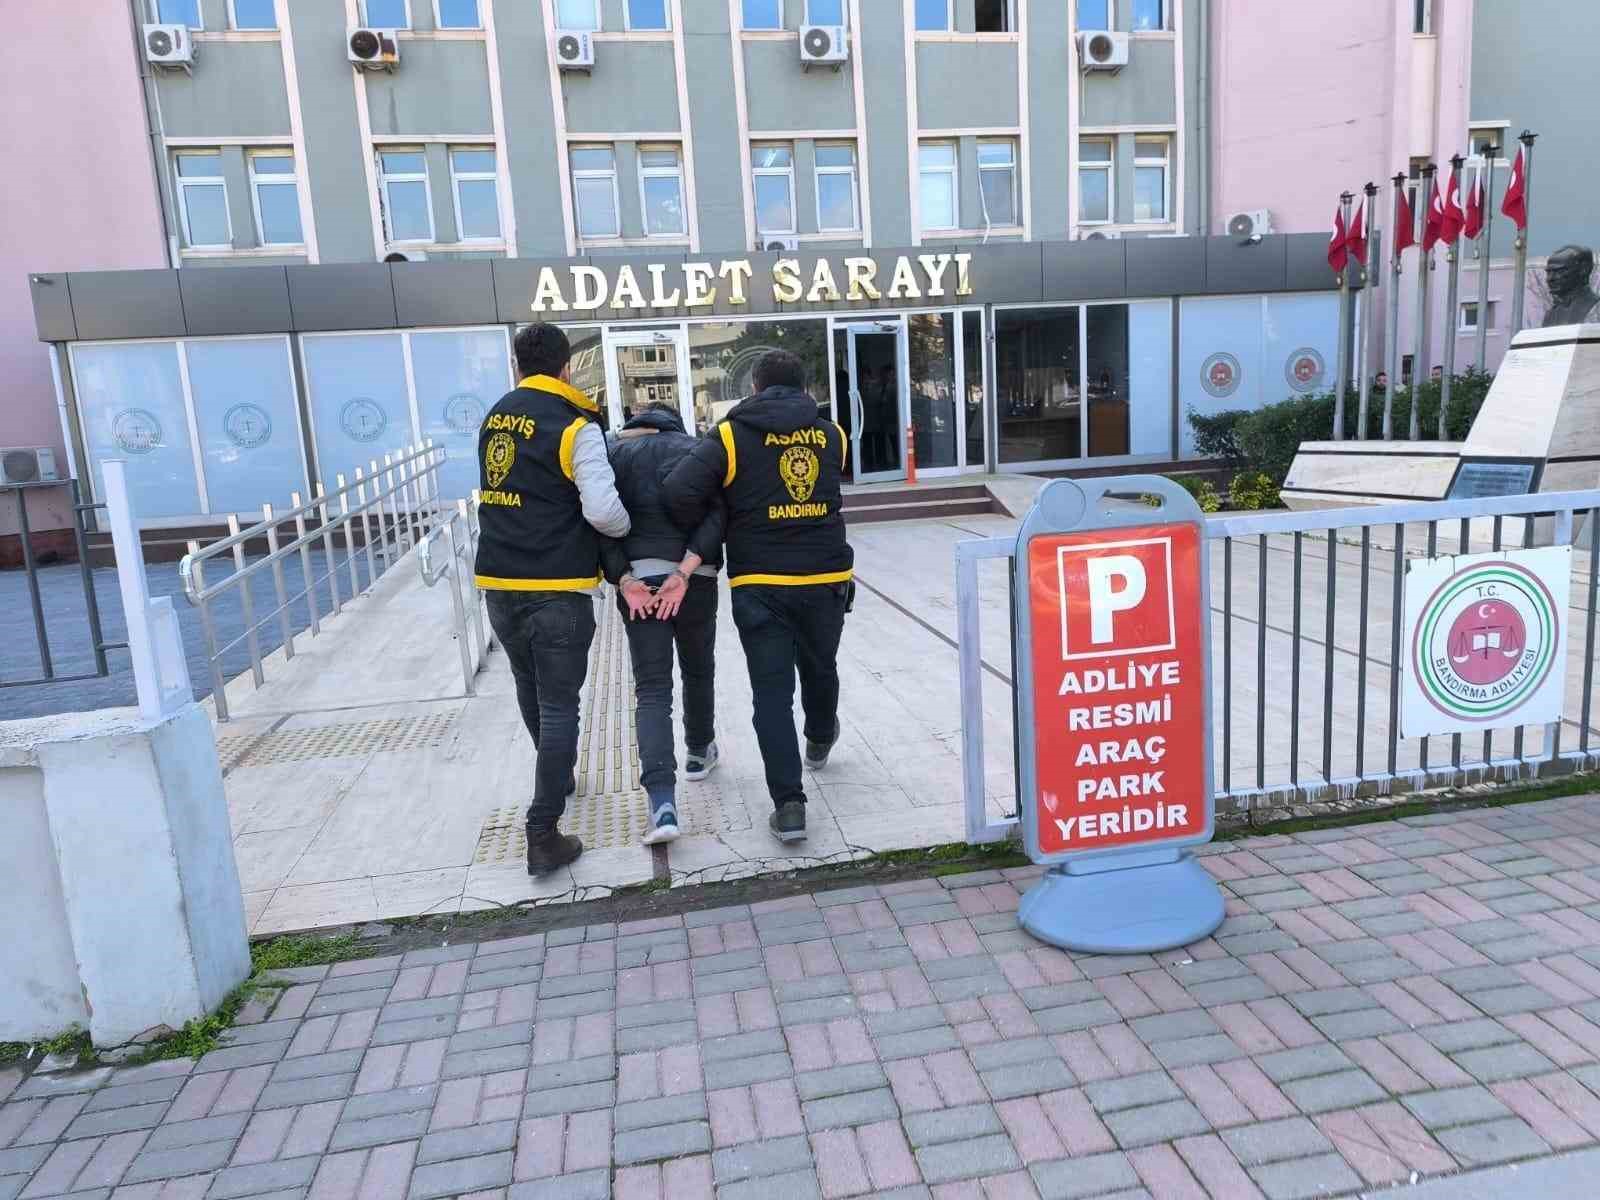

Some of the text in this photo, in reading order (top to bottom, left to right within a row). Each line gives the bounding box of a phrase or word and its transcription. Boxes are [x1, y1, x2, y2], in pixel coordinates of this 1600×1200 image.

[530, 252, 972, 312] ADALET SARAYI
[485, 413, 536, 440] ASAYİŞ
[764, 426, 827, 448] ASAYİŞ
[768, 503, 828, 519] BANDIRMA
[1087, 555, 1147, 644] P
[1058, 660, 1181, 695] ADLİYE
[1435, 657, 1487, 699] BANDIRMA
[1069, 693, 1172, 731] RESMİ
[1074, 736, 1167, 767] ARAÇ
[1077, 771, 1166, 803] PARK
[1055, 801, 1188, 841] YERİDİR
